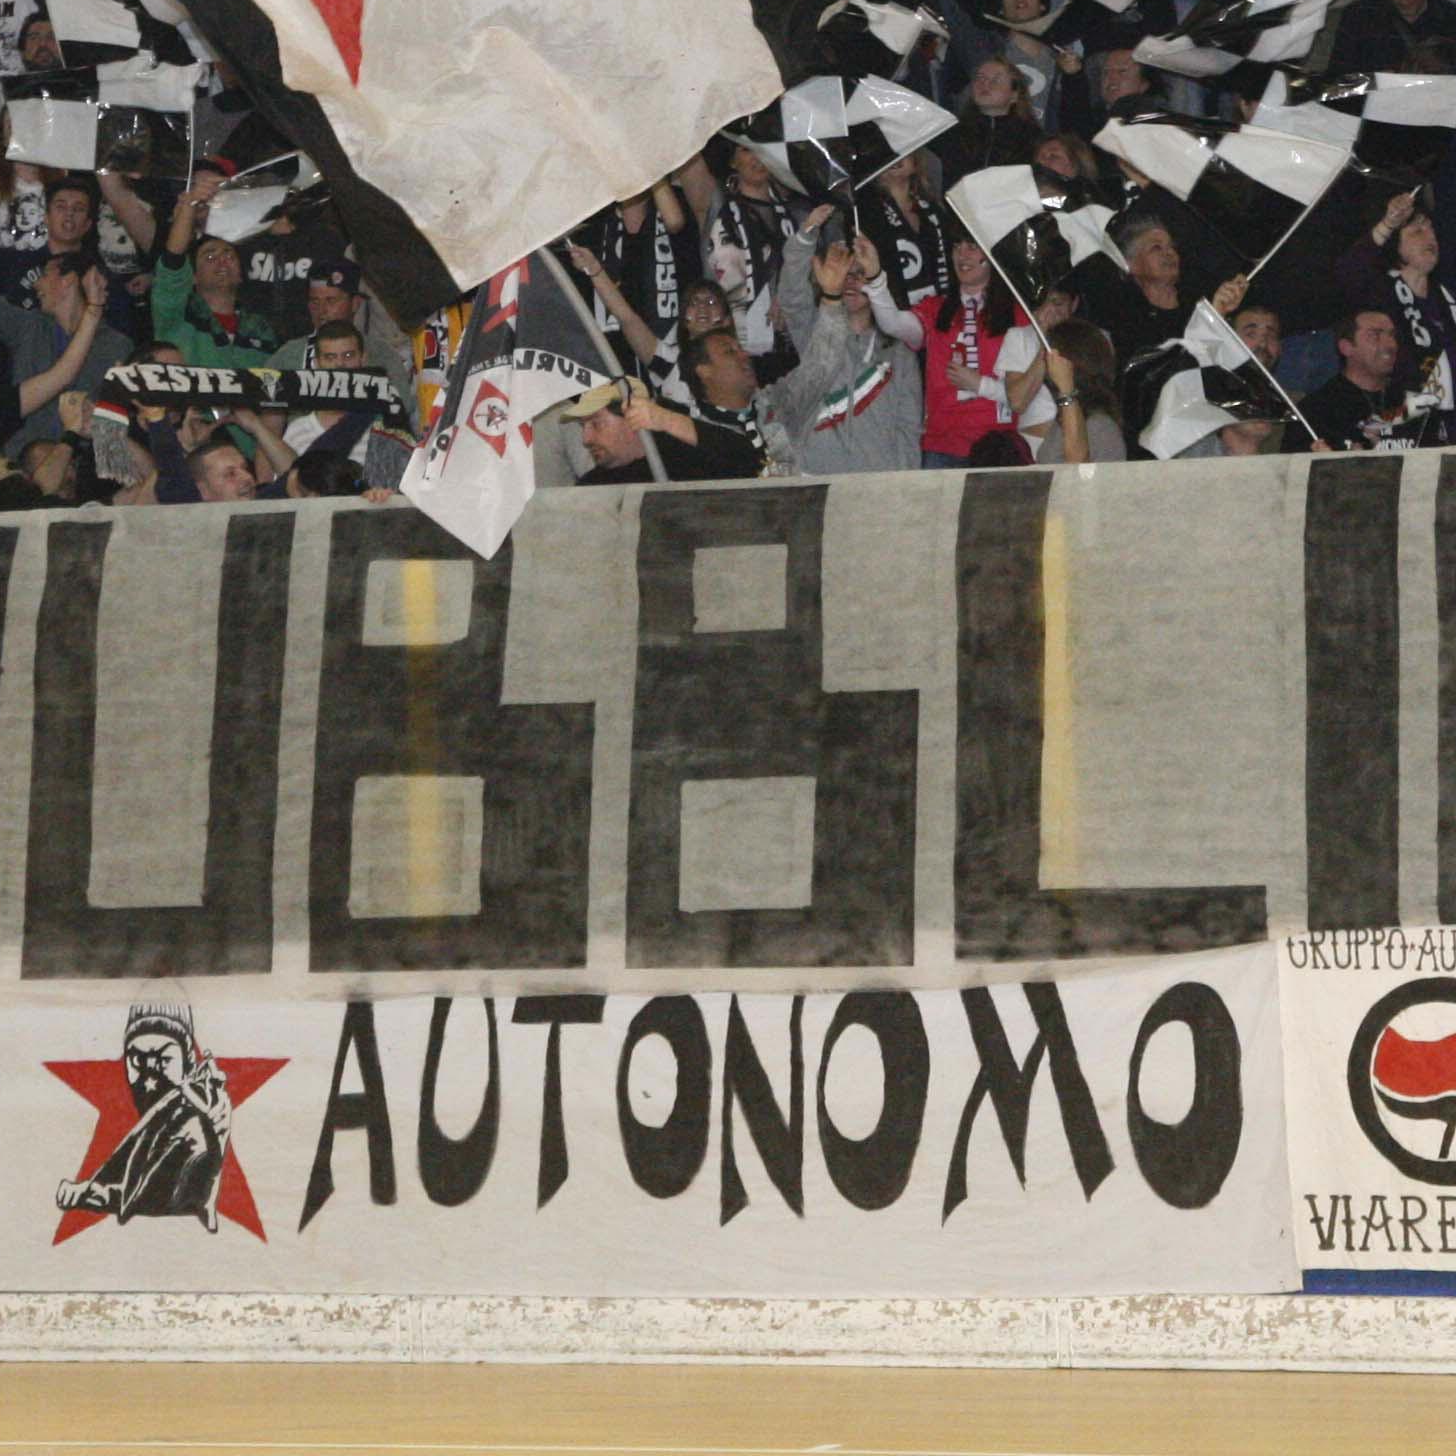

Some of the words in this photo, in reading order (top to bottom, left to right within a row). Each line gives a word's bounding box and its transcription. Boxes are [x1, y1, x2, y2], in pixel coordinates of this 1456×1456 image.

[105, 363, 244, 394] TESTE
[1287, 926, 1407, 971] GRUPPO
[299, 980, 1241, 1233] AUTONOMO
